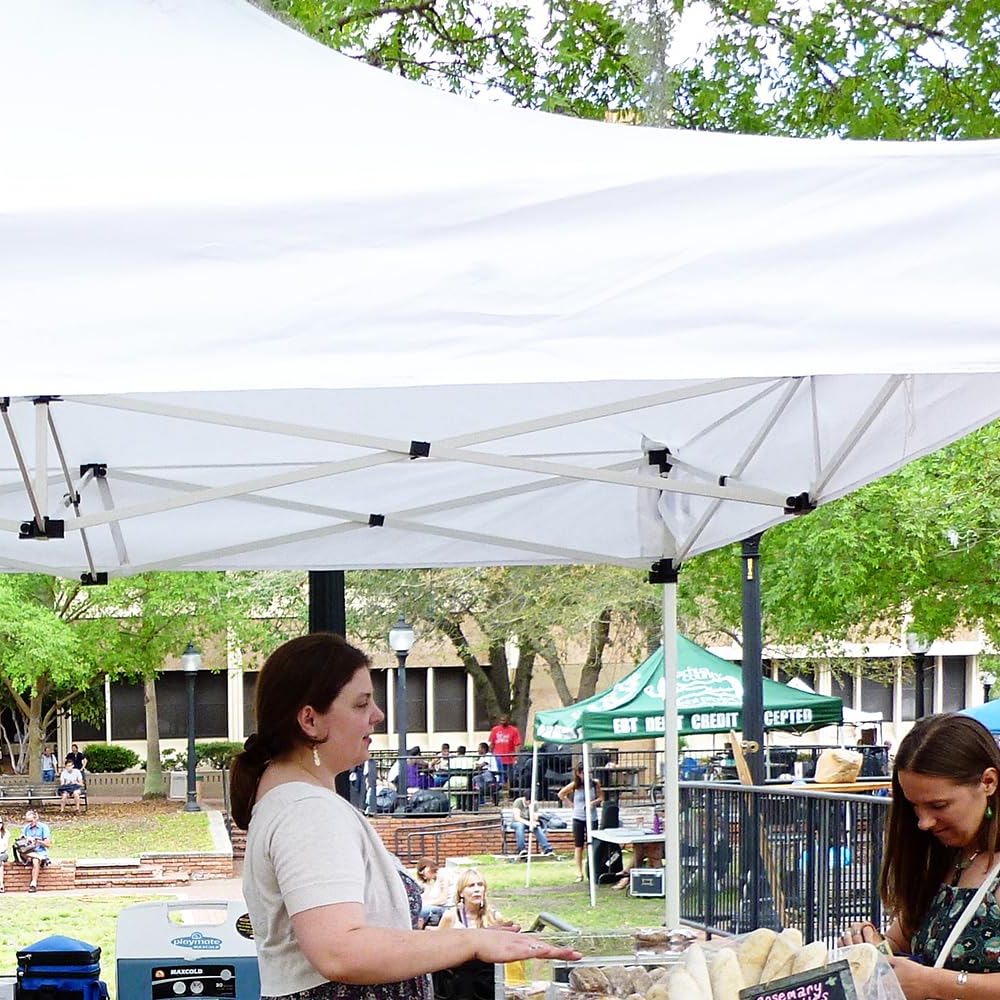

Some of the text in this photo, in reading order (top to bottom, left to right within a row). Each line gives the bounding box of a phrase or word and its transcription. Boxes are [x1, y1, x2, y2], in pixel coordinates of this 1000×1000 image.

[691, 711, 739, 730] CREDIT
[762, 707, 813, 727] CEPTED
[170, 968, 204, 976] MAXCOLD
